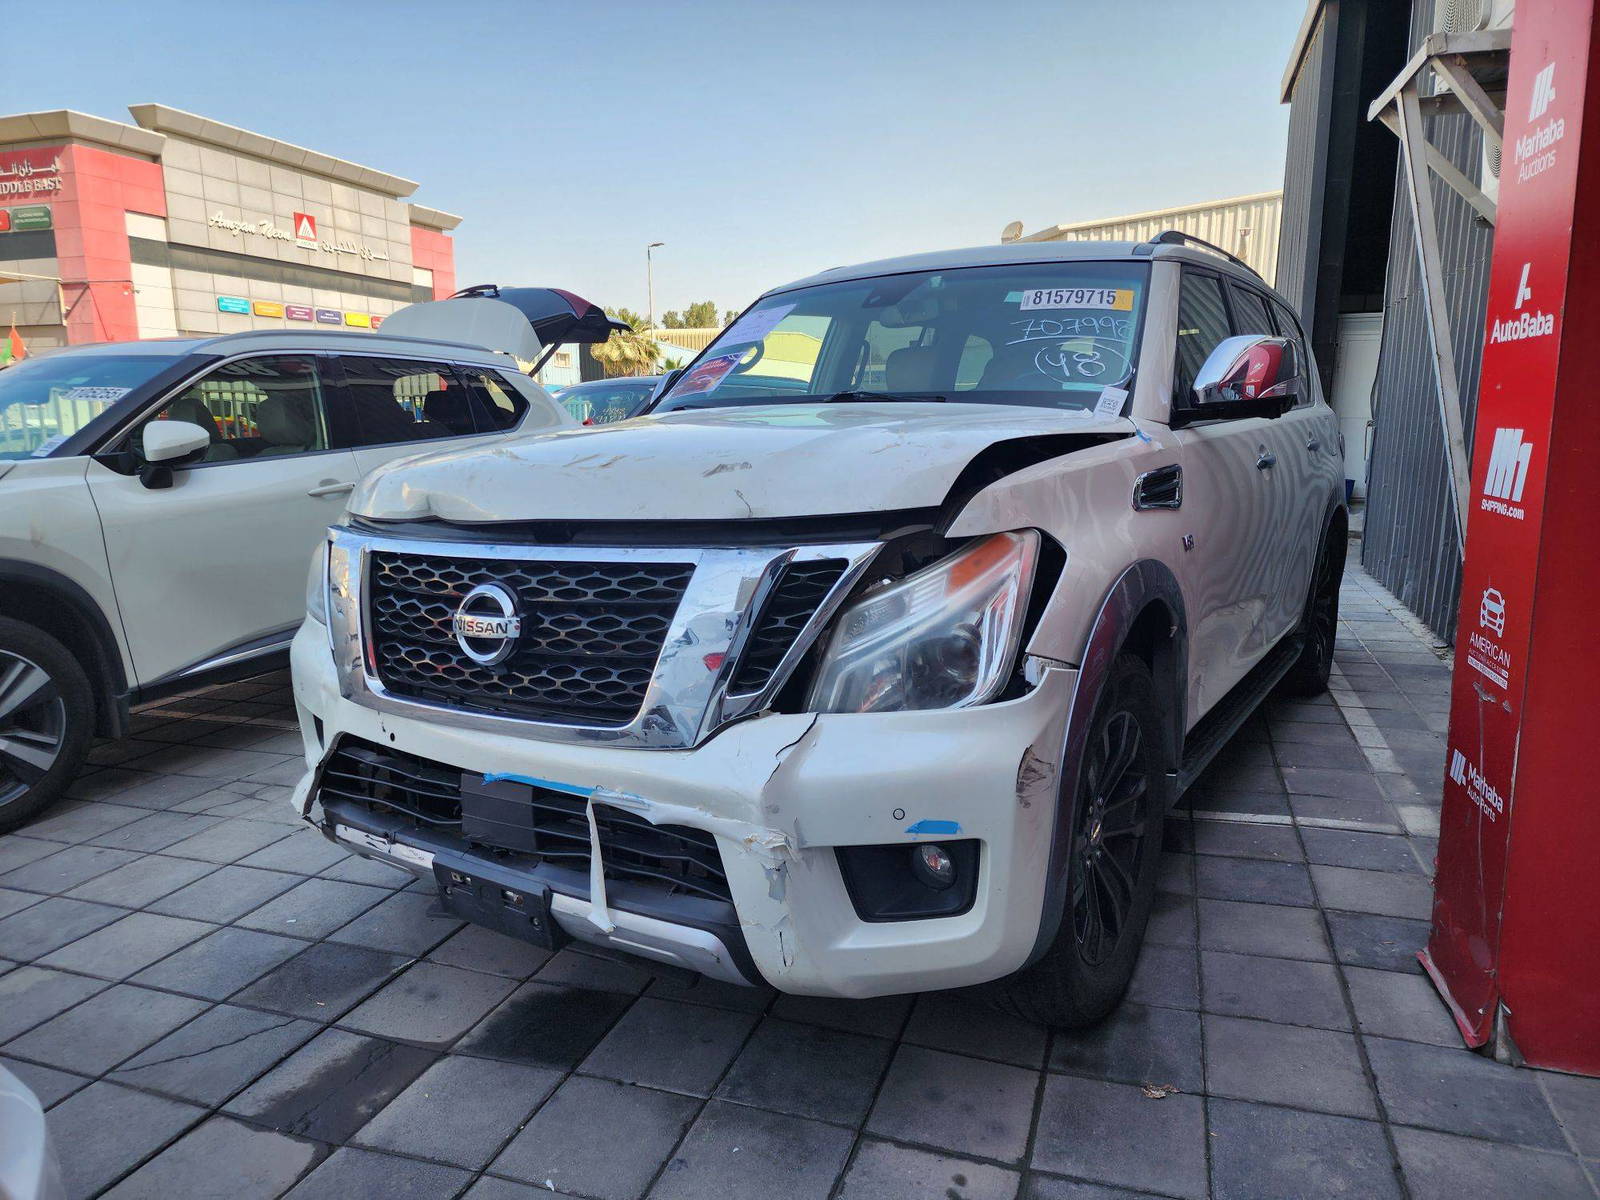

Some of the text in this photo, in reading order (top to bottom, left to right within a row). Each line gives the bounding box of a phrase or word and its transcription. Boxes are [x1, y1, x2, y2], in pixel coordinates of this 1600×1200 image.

[1514, 117, 1565, 166] Marhaba
[1517, 149, 1557, 185] Auctions
[33, 176, 62, 191] EAST
[1032, 290, 1117, 305] 81579715
[1490, 310, 1554, 344] AutoBaba
[1045, 351, 1106, 378] 48
[1481, 498, 1525, 521] SHIPPING.com
[456, 616, 508, 635] NISSAN
[1469, 631, 1511, 669] AMERICAN
[1468, 762, 1504, 815] Marhaba
